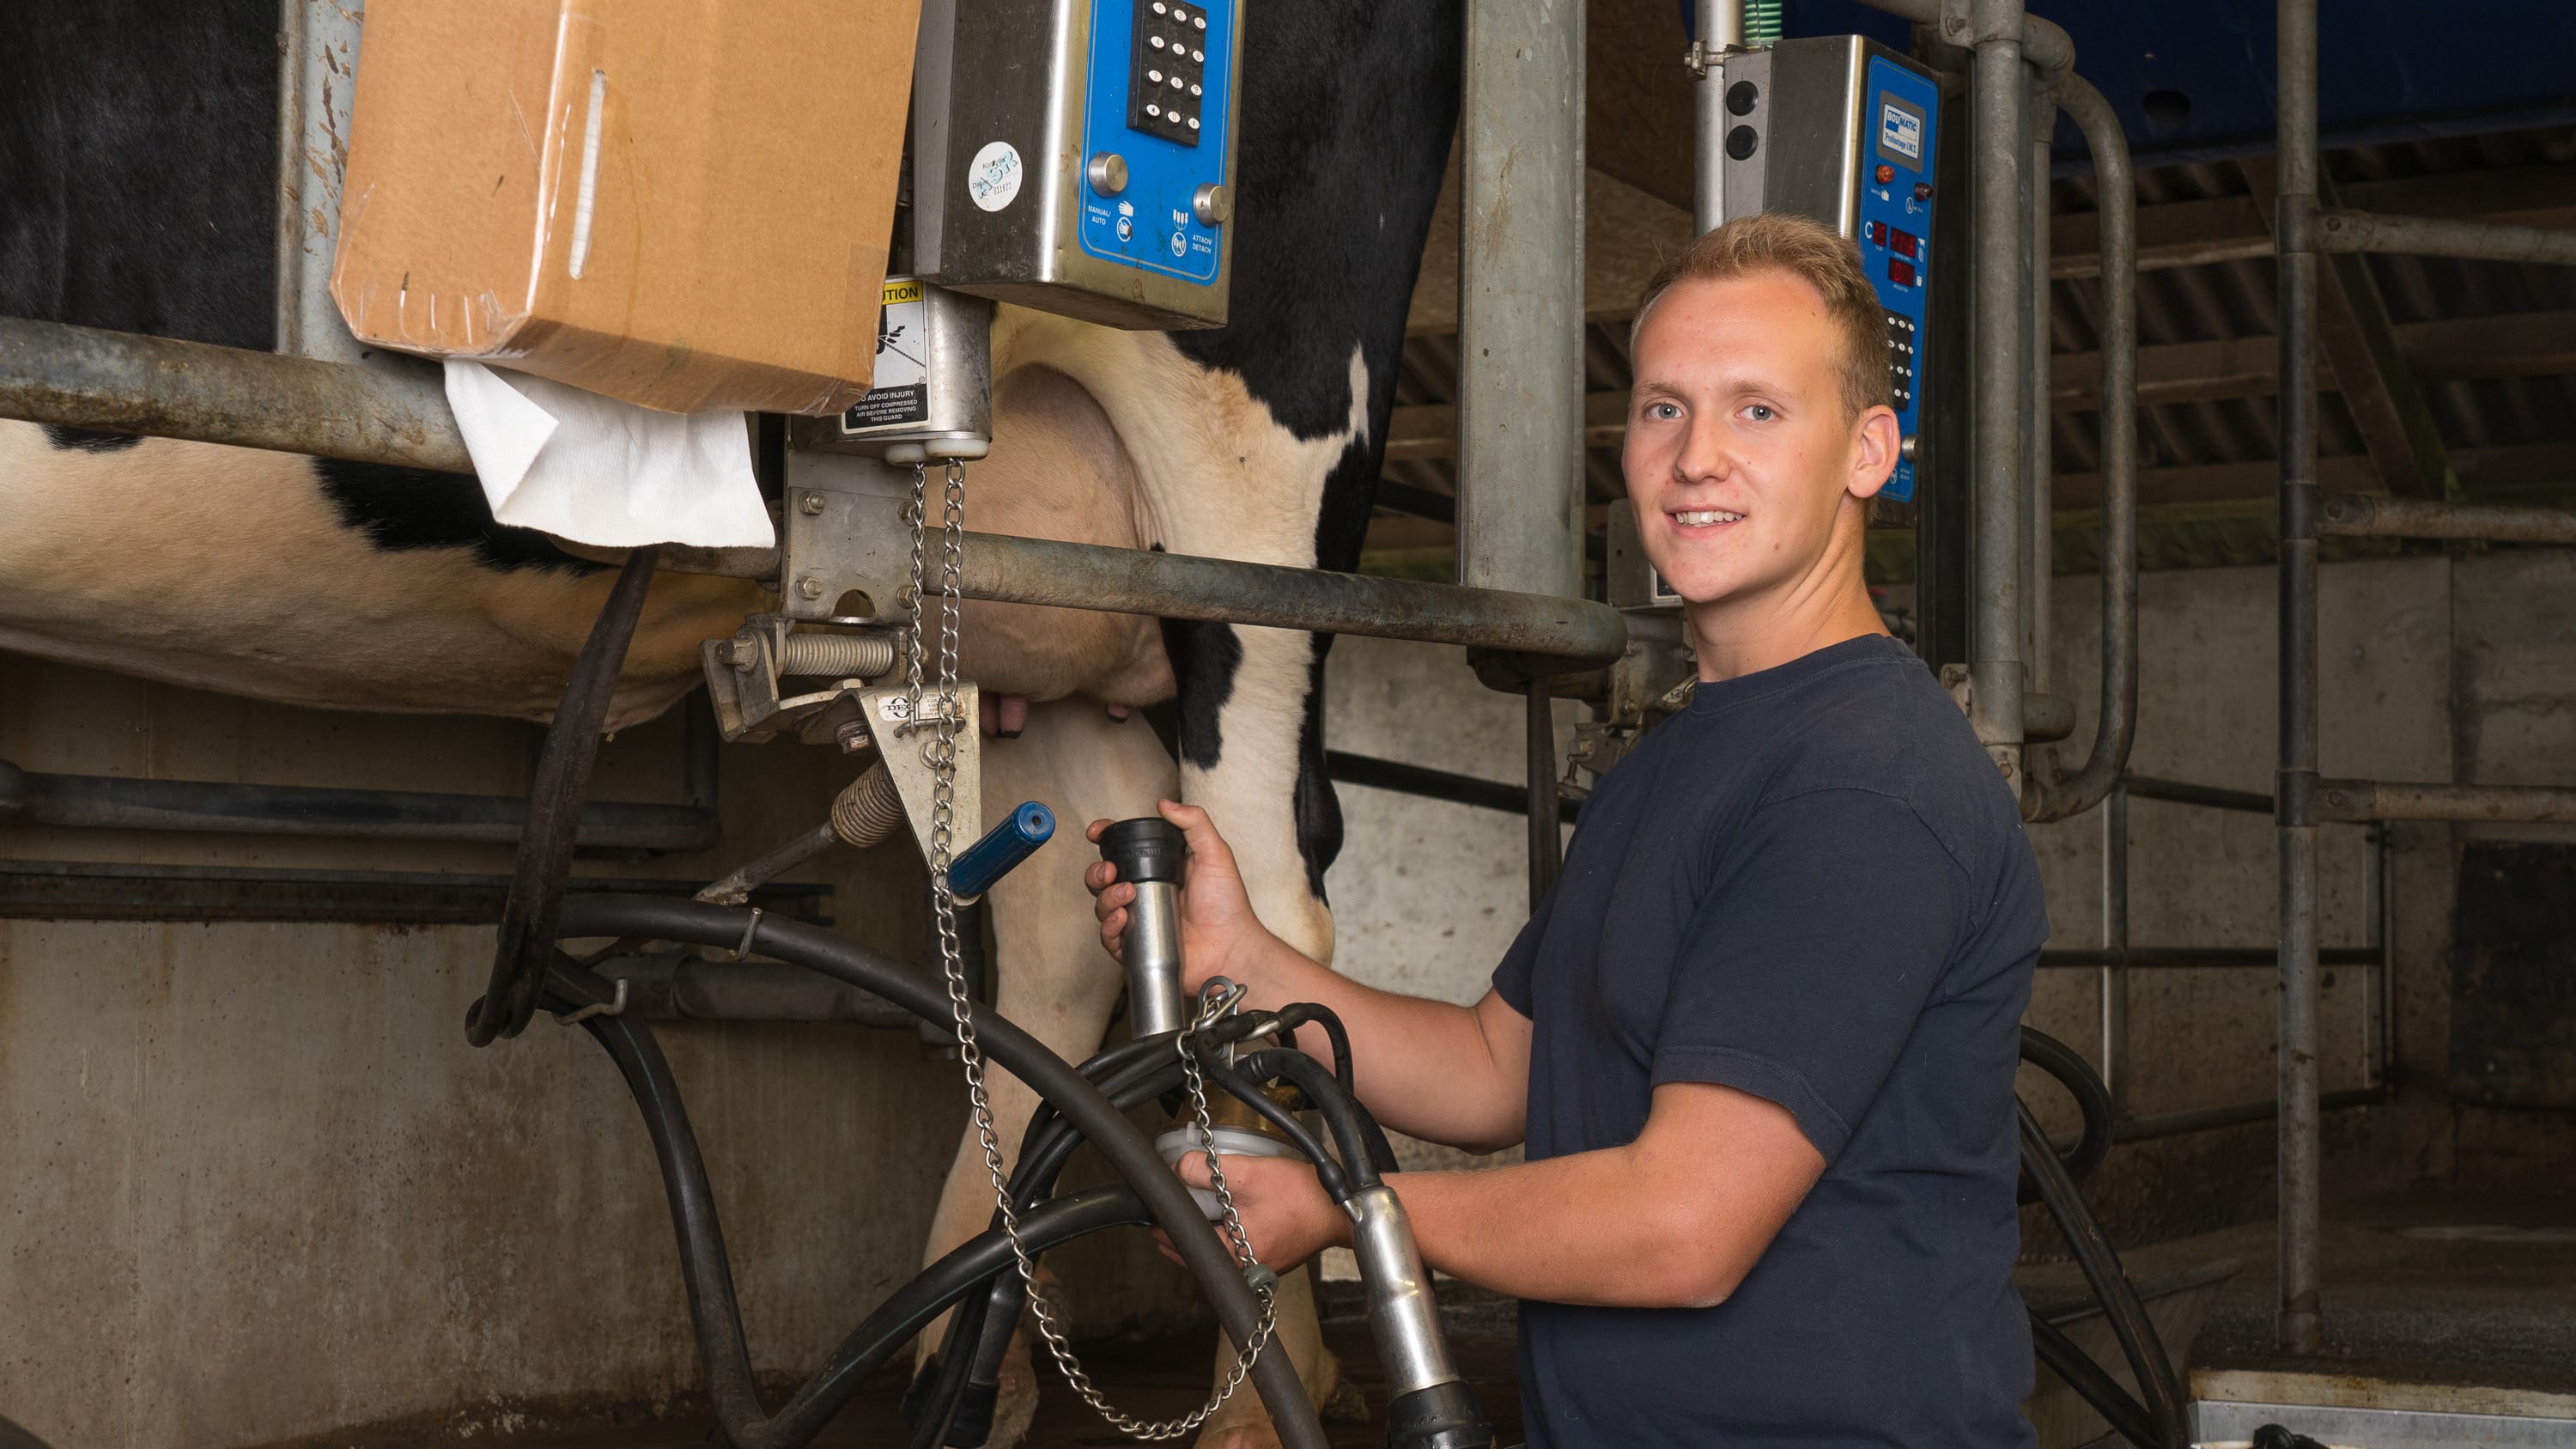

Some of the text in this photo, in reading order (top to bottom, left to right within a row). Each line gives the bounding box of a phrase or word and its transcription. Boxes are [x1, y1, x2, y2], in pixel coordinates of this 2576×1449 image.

[1088, 204, 1111, 217] MANUAL/
[1092, 216, 1107, 226] AUTO
[1192, 243, 1212, 254] DETACH
[867, 393, 889, 401] AVOID
[890, 390, 914, 399] INJURY
[881, 399, 918, 408] COMPRESSED
